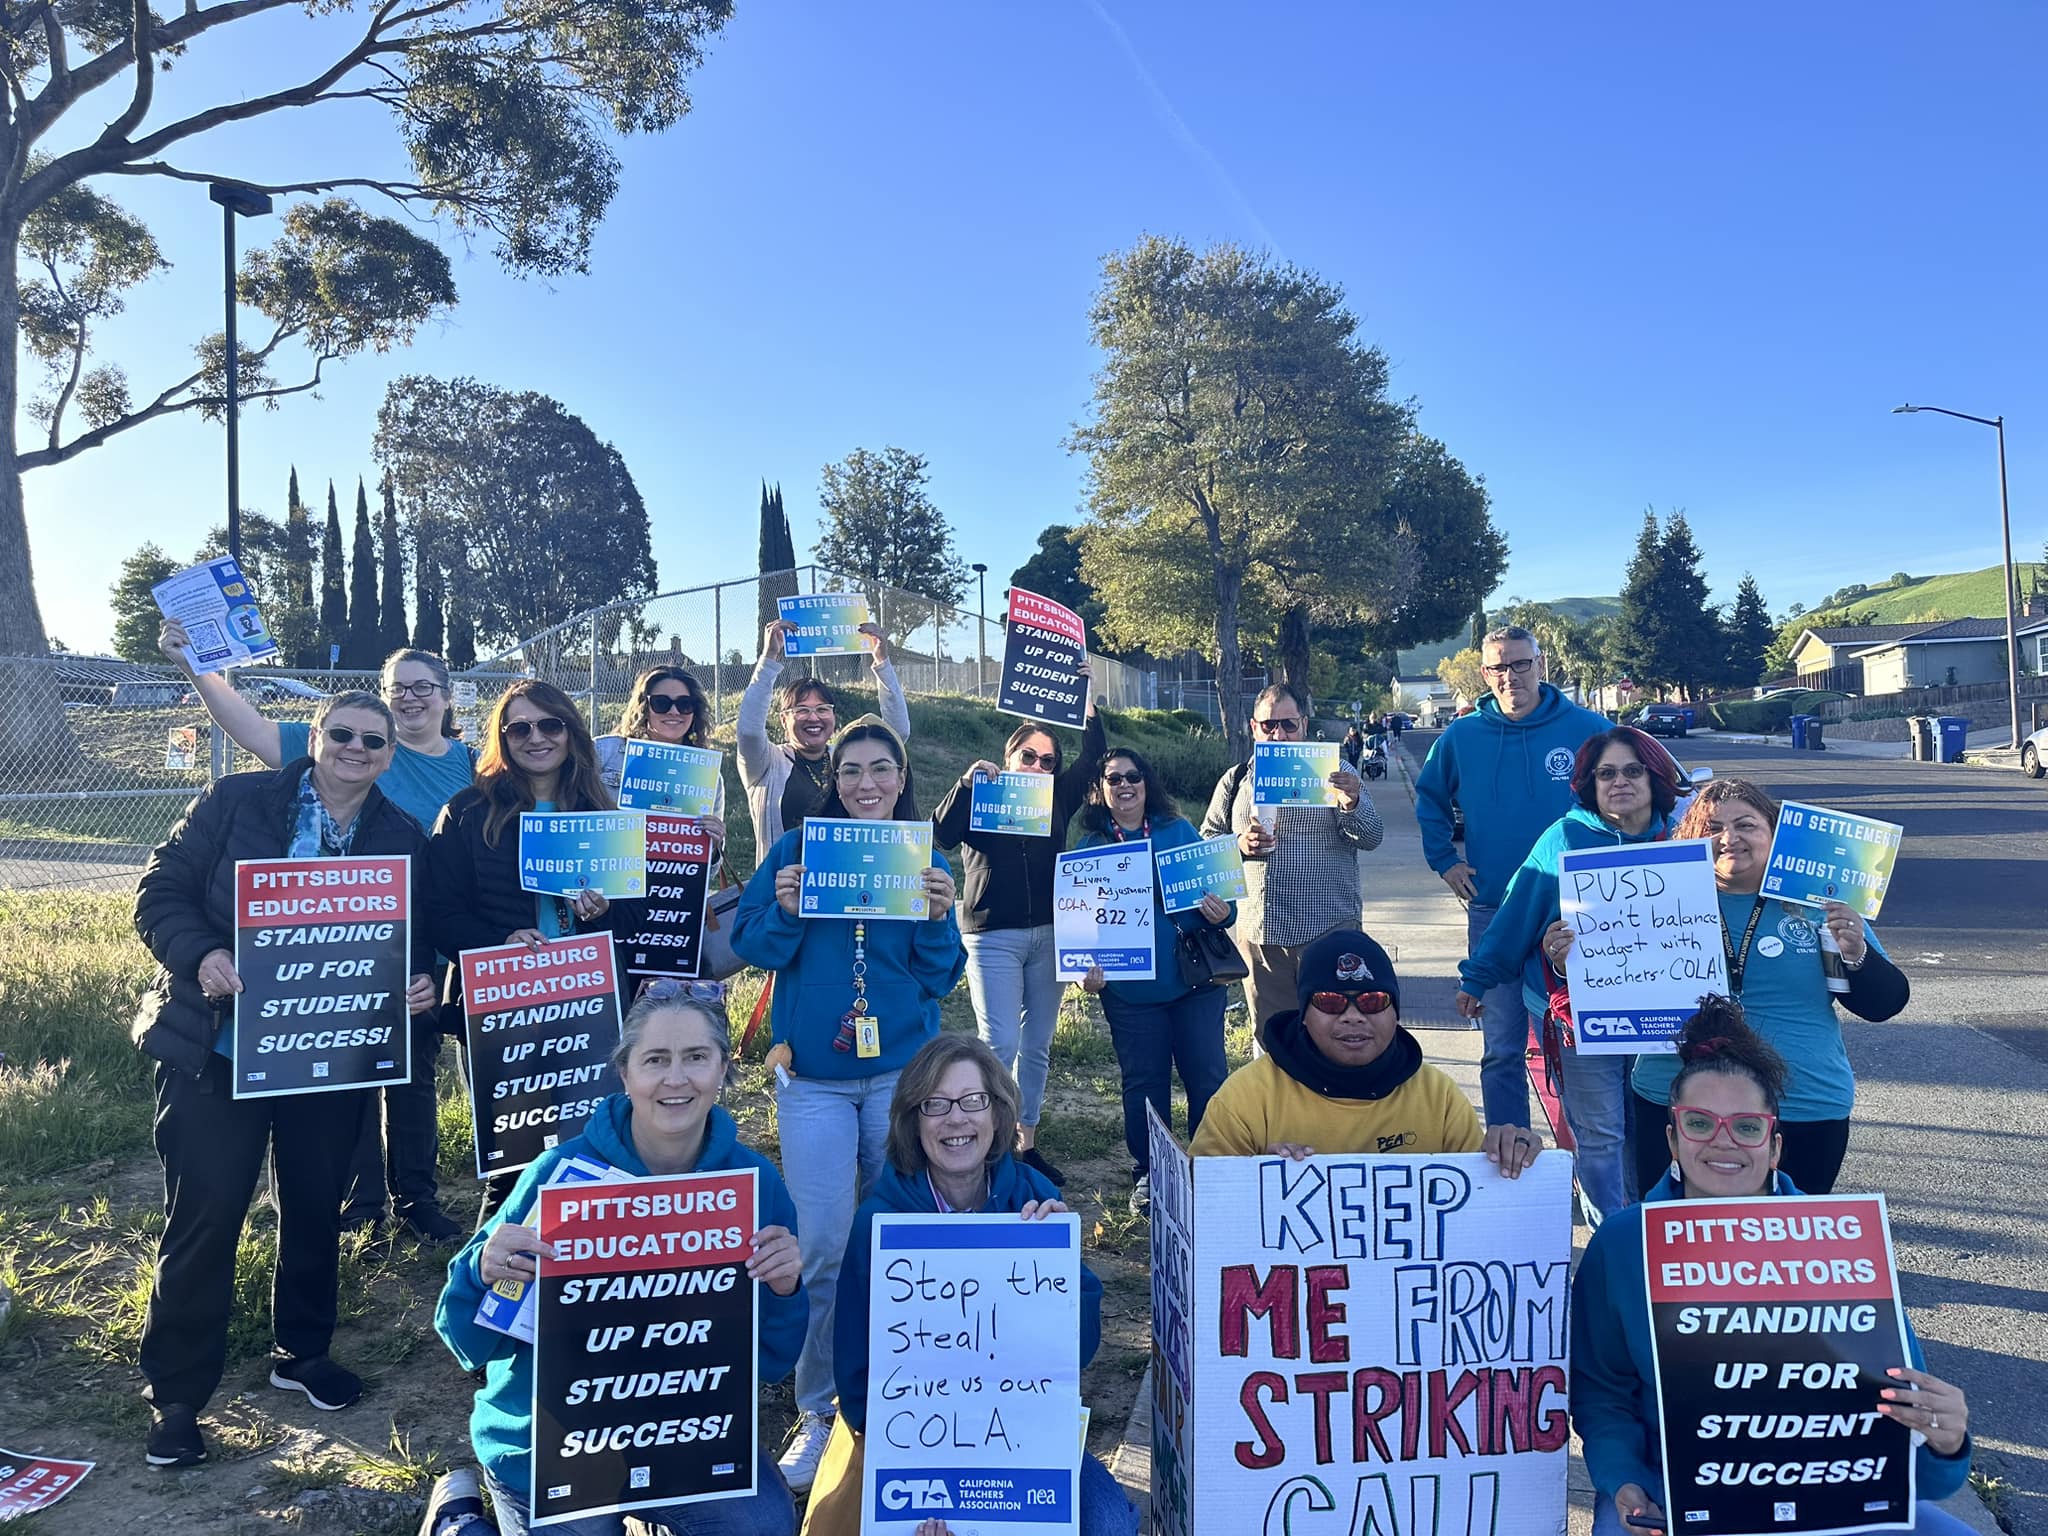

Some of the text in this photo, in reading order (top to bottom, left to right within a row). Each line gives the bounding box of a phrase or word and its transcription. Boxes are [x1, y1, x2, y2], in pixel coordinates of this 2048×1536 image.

[781, 601, 794, 611] NO
[1017, 595, 1079, 626] PITTSBURG
[1014, 607, 1081, 639] EDUCATORS
[1015, 624, 1081, 650] STANDING
[1024, 644, 1074, 665] UP FOR
[1014, 662, 1079, 686] STUDENT
[1010, 681, 1079, 705] SUCCESS!
[628, 744, 719, 768] NO SETTLEMENT
[1256, 746, 1270, 757] NO
[624, 777, 714, 800] AUGUST STRIKE
[976, 774, 988, 784] NO
[1257, 776, 1297, 788] AUGUST
[974, 802, 1012, 815] AUGUST
[524, 817, 646, 833] NO SETTLEMENT
[646, 822, 702, 837] SBURG
[807, 826, 930, 844] NO SETTLEMENT
[1782, 809, 1900, 848] NO SETTLEMENT
[525, 857, 641, 873] AUGUST STRIKE
[1062, 856, 1131, 875] COST of
[1159, 839, 1238, 866] NO SETTLEMENT
[253, 868, 393, 889] PITTSBURG
[646, 861, 699, 875] NDING
[807, 872, 867, 888] AUGUST
[1772, 854, 1888, 892] AUGUST STRIKE
[648, 885, 684, 899] FOR
[1165, 869, 1243, 895] AUGUST STRIKE
[1574, 868, 1665, 904] PUSD
[248, 895, 398, 917] EDUCATORS
[1135, 908, 1149, 927] %
[1576, 904, 1641, 936] Don't
[1652, 898, 1719, 929] balance
[254, 923, 394, 947] STANDING
[1788, 922, 1807, 930] PEA
[475, 945, 599, 977] PITTSBURG
[1062, 953, 1096, 968] CTA
[1579, 932, 1702, 967] budget with
[276, 959, 375, 981] UP FOR
[1669, 953, 1723, 986] COLA!
[473, 970, 606, 1004] EDUCATORS
[260, 992, 390, 1018] STUDENT
[481, 997, 604, 1033] STANDING
[257, 1026, 393, 1054] SUCCESS!
[1583, 1017, 1639, 1036] CTA
[502, 1033, 590, 1063] UP FOR
[492, 1063, 607, 1100] STUDENT
[492, 1096, 605, 1133] SUCCESS
[1376, 1133, 1404, 1150] PEA
[560, 1188, 737, 1223] PITTSBURG
[1259, 1159, 1471, 1260] KEEP
[1664, 1215, 1862, 1244] PITTSBURG
[553, 1226, 742, 1262] EDUCATORS
[1153, 1196, 1189, 1318] CLASS
[560, 1267, 737, 1304] STANDING
[1661, 1259, 1876, 1286] EDUCATORS
[885, 1258, 1069, 1318] Stop the
[1220, 1260, 1571, 1366] ME FROM
[1676, 1305, 1876, 1334] STANDING
[586, 1319, 712, 1353] UP FOR
[887, 1302, 997, 1361] Steal!
[566, 1365, 731, 1405] STUDENT
[882, 1366, 1052, 1400] Give us our
[1714, 1362, 1860, 1390] UP FOR
[885, 1407, 1021, 1452] COLA.
[1234, 1366, 1571, 1470] STRIKING
[1696, 1412, 1884, 1439] STUDENT
[560, 1414, 733, 1458] SUCCESS!
[959, 1479, 1014, 1489] CALIFORNIA
[1695, 1456, 1888, 1486] SUCCESS!
[881, 1479, 954, 1511] CTA
[959, 1490, 1004, 1499] TEACHERS
[959, 1500, 1021, 1511] ASSOCIATION
[1026, 1487, 1056, 1506] nea
